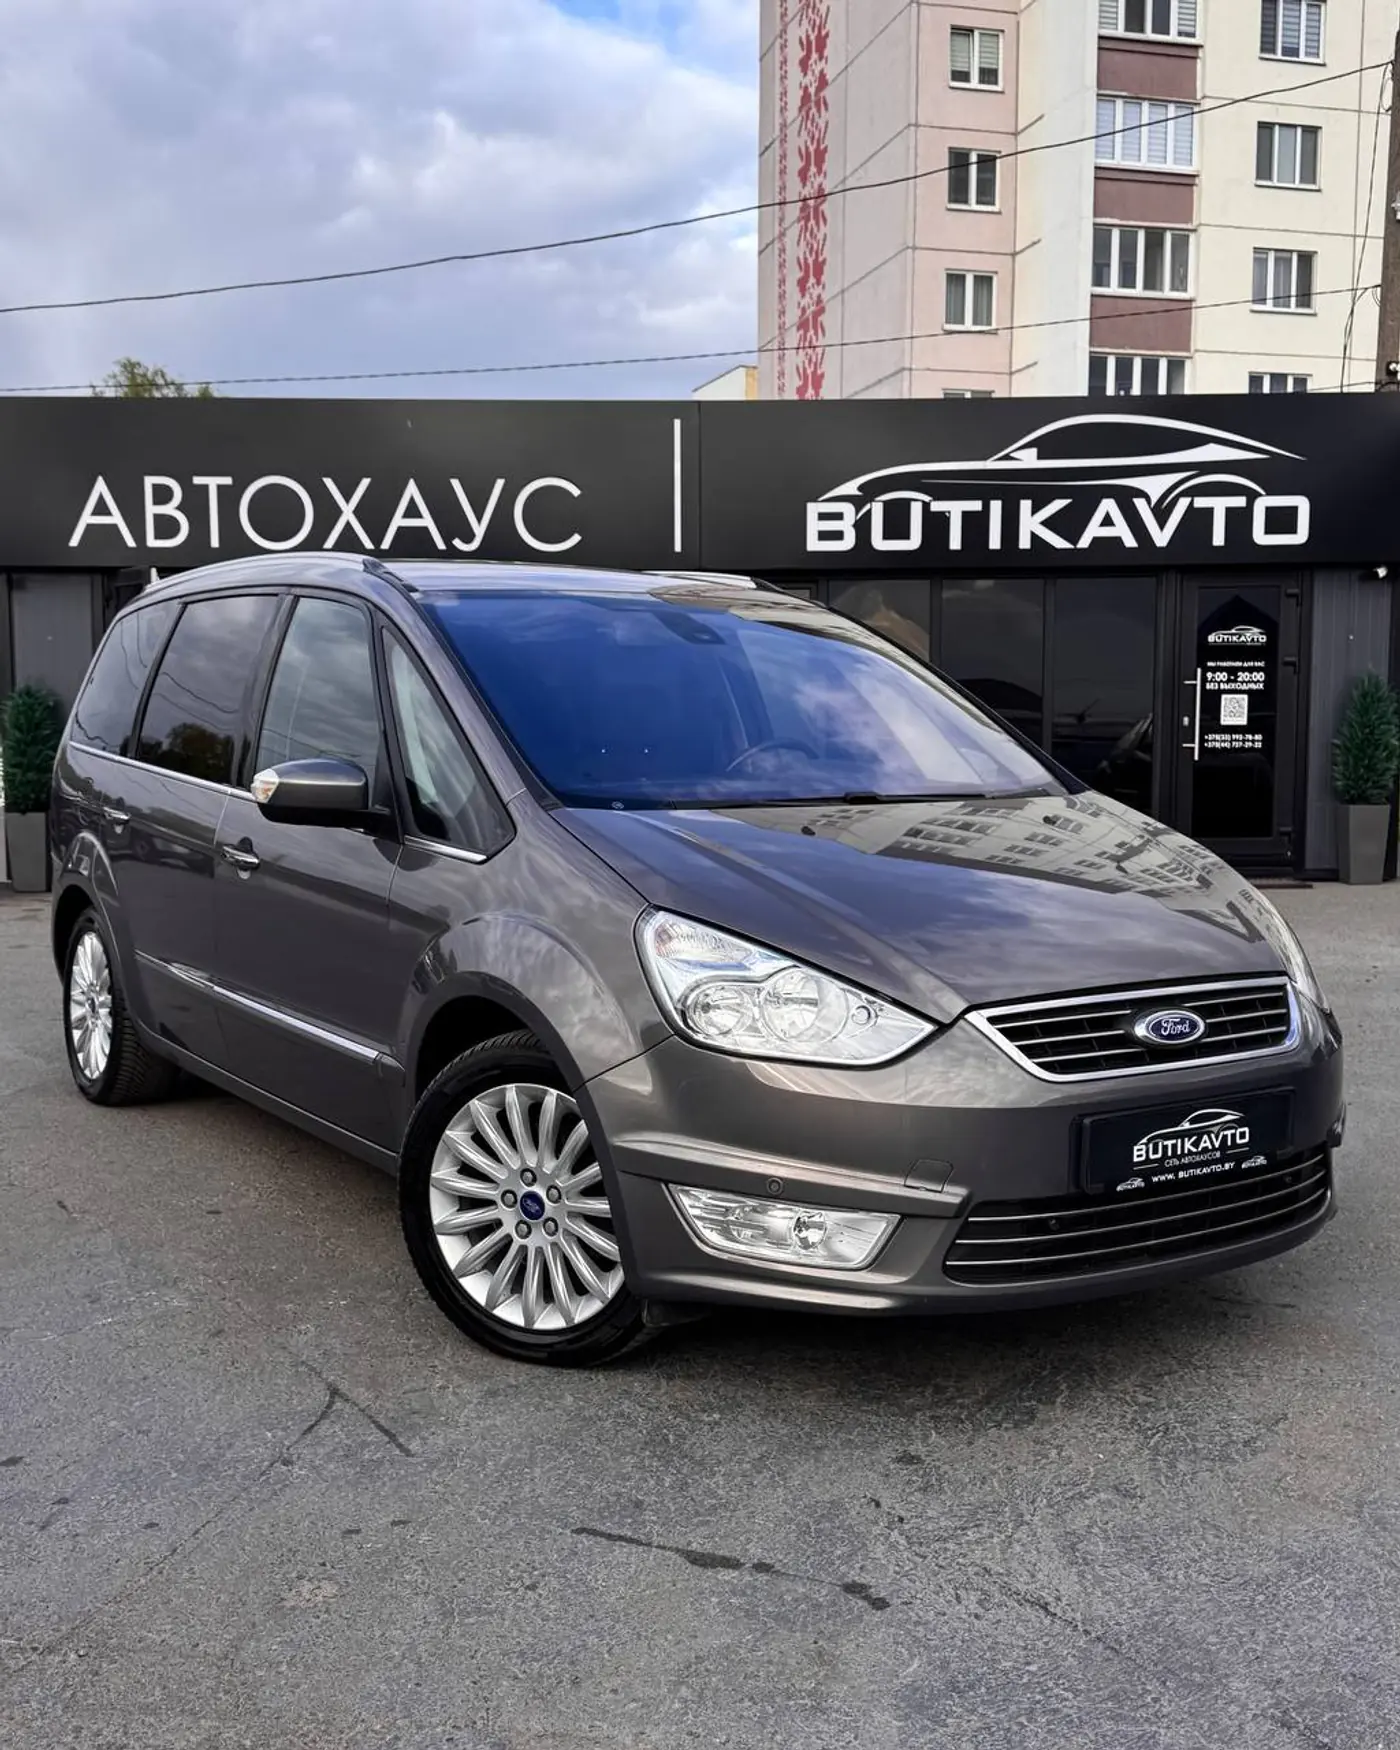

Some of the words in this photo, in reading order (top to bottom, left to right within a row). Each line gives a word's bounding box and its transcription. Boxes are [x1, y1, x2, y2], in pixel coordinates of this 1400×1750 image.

[68, 475, 583, 552] АВТОХАУС
[806, 494, 1311, 553] BUTIKAVTO
[1208, 634, 1267, 643] BUTIKAVTO
[1206, 671, 1228, 681] 9:00
[1237, 671, 1265, 681] 20:00
[1160, 1018, 1191, 1035] Ford
[1133, 1127, 1250, 1162] BUTIKAVTO
